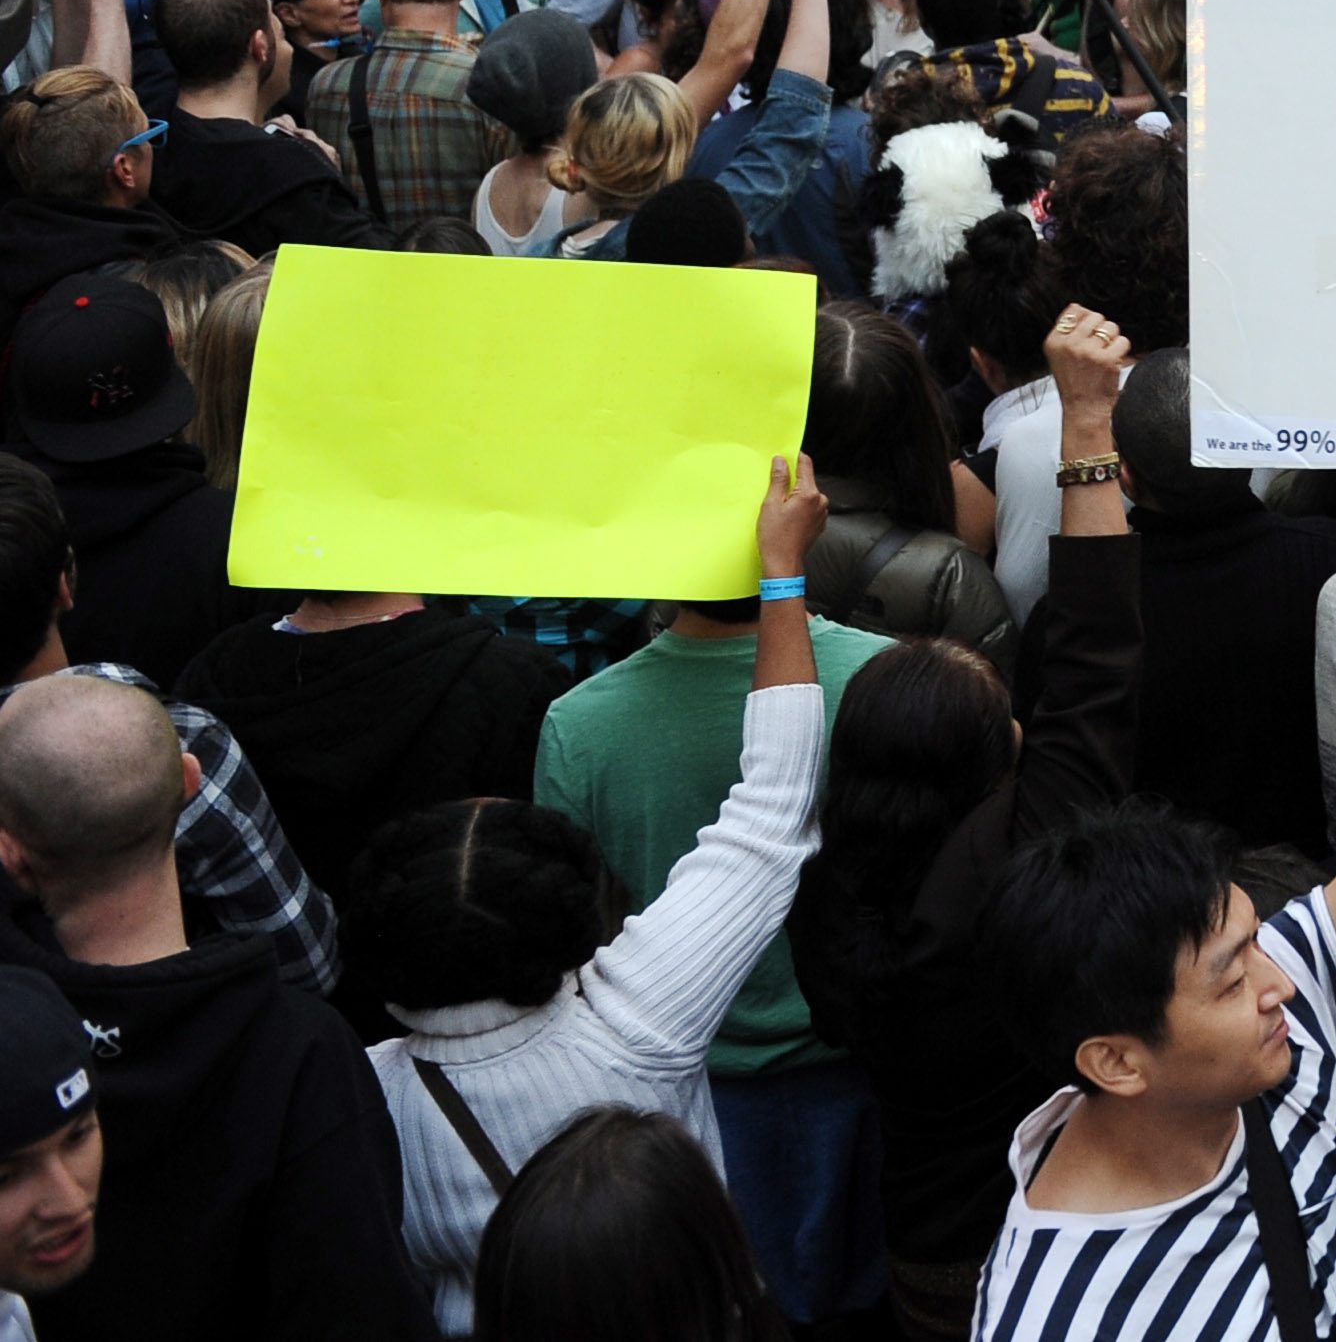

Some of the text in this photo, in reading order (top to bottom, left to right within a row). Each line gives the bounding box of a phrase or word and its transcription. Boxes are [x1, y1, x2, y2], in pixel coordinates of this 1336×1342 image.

[1207, 429, 1336, 454] We are the 99%
